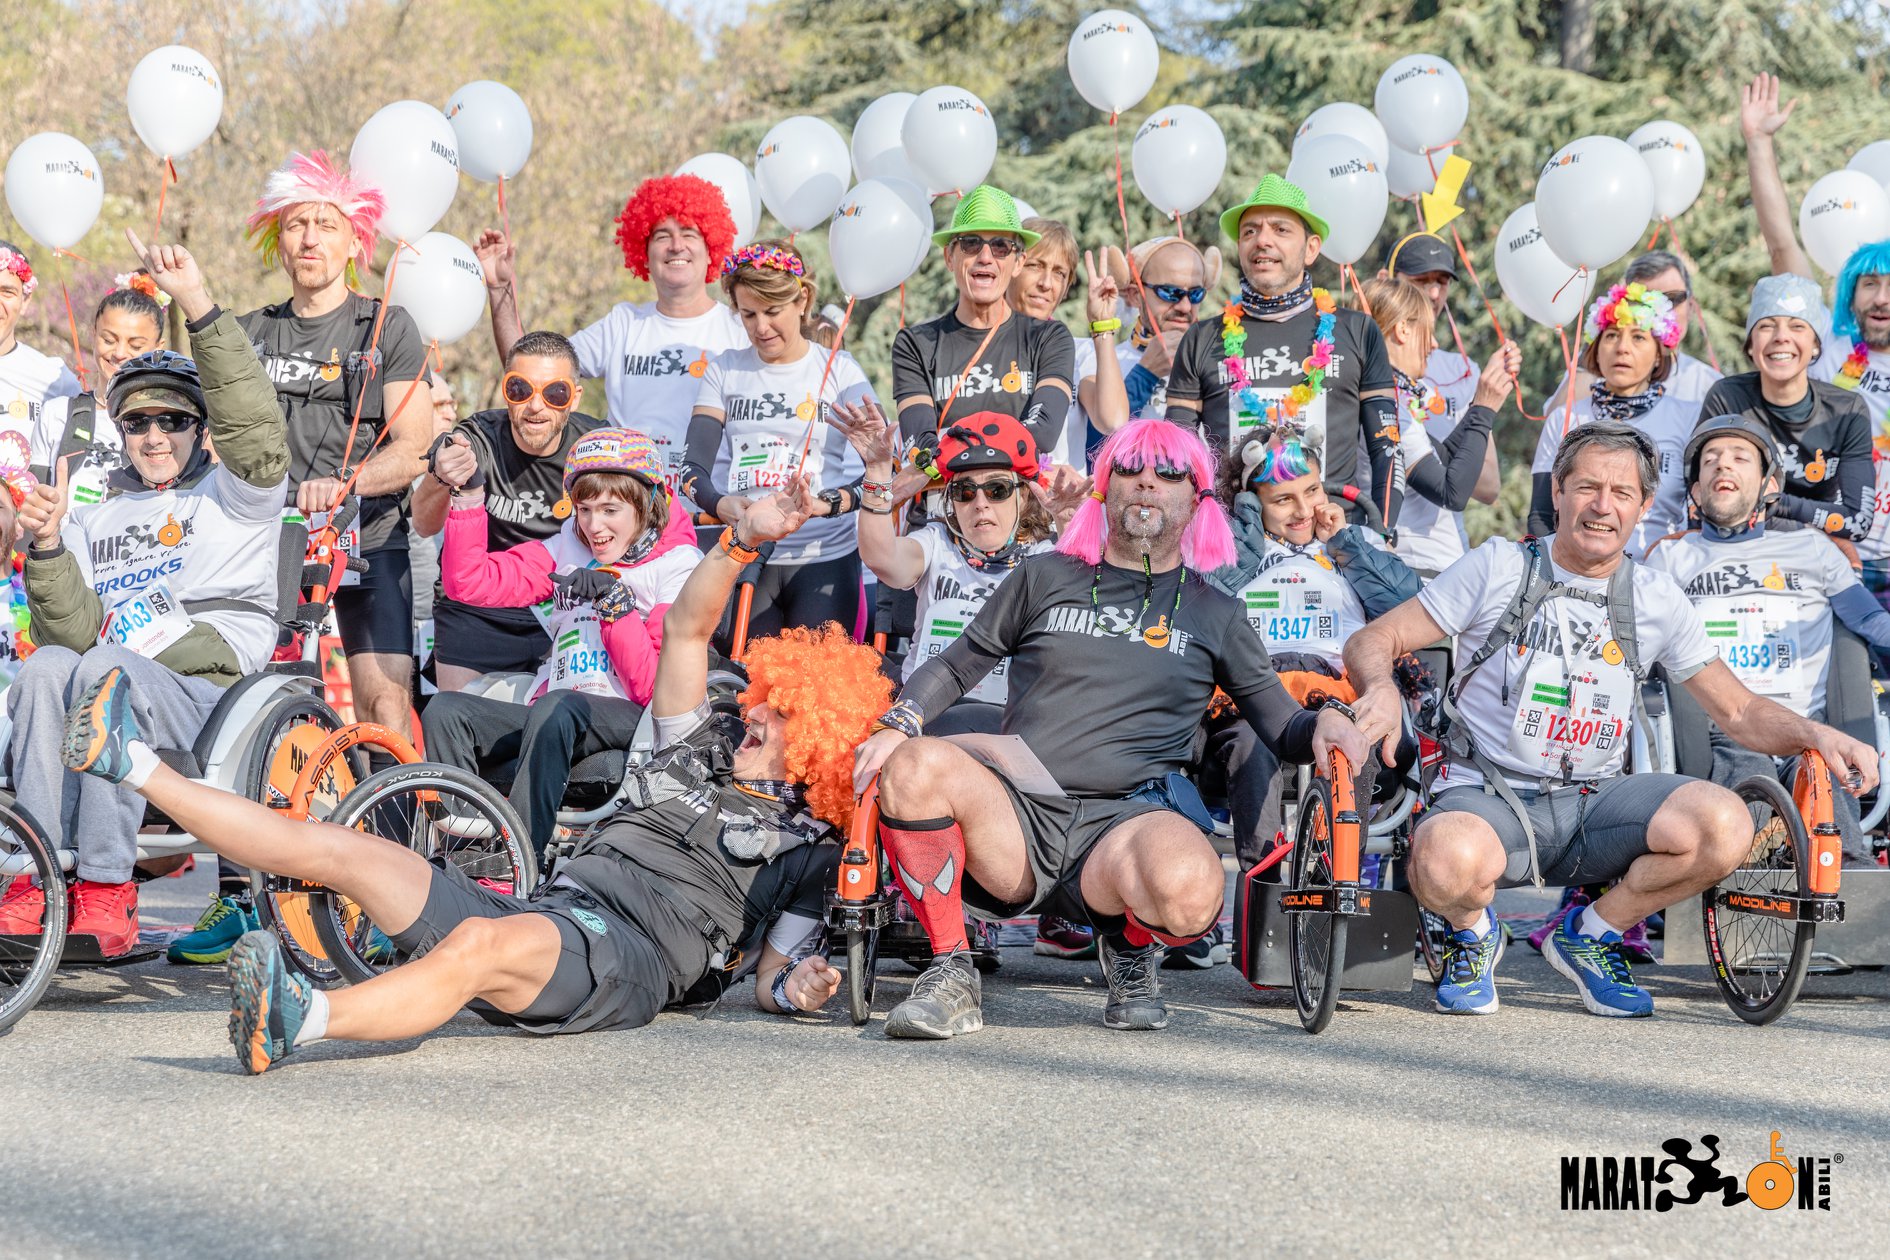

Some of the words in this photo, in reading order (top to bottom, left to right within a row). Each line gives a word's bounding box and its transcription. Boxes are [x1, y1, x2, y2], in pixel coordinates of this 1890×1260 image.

[94, 557, 183, 596] BROOKS
[1530, 556, 1542, 587] SALOMON
[114, 601, 153, 644] 5463
[1268, 616, 1311, 640] 4347
[1179, 631, 1188, 656] ABILI
[570, 650, 609, 674] 4343
[1728, 644, 1771, 668] 4353
[580, 681, 608, 689] Santander
[1546, 713, 1594, 746] 1230
[387, 770, 443, 785] KOJAK
[1729, 894, 1791, 913] MADDILINE
